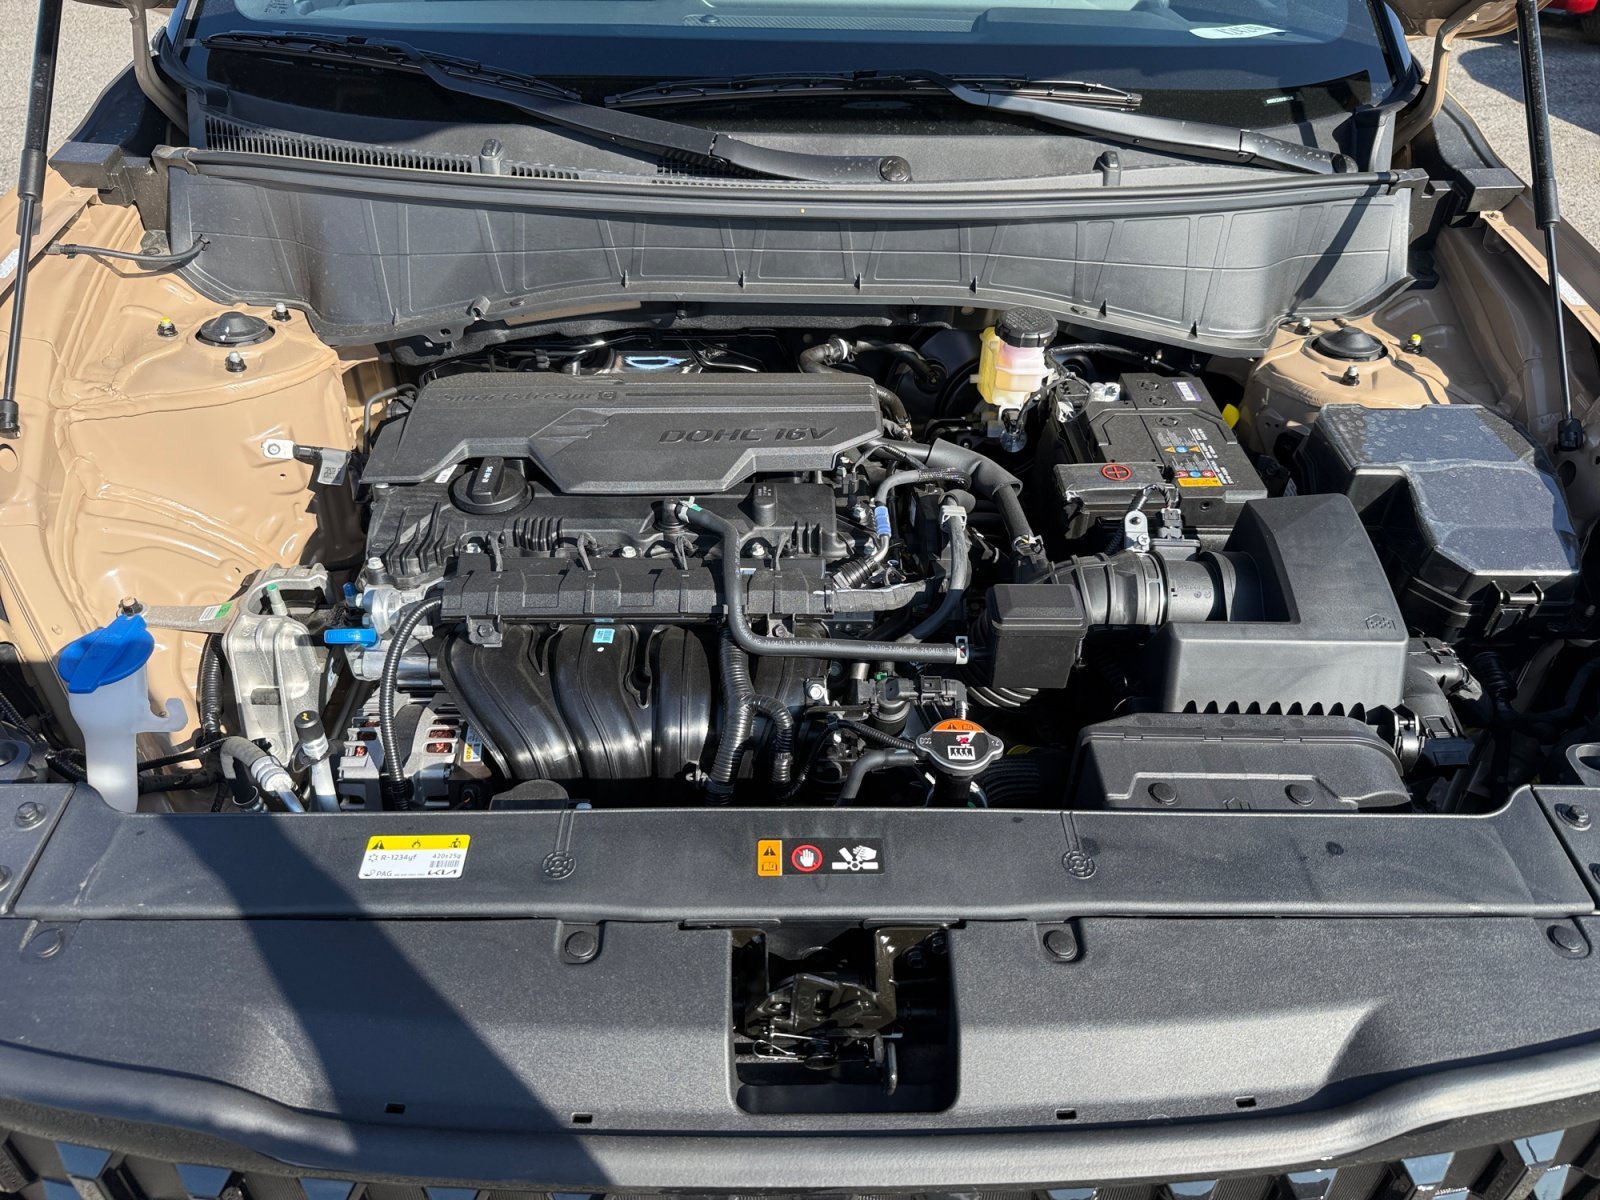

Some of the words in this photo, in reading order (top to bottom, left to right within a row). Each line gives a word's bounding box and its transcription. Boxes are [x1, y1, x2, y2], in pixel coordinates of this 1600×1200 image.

[658, 428, 768, 443] DOHC
[774, 427, 838, 441] 16V
[380, 853, 417, 862] R-1234yf
